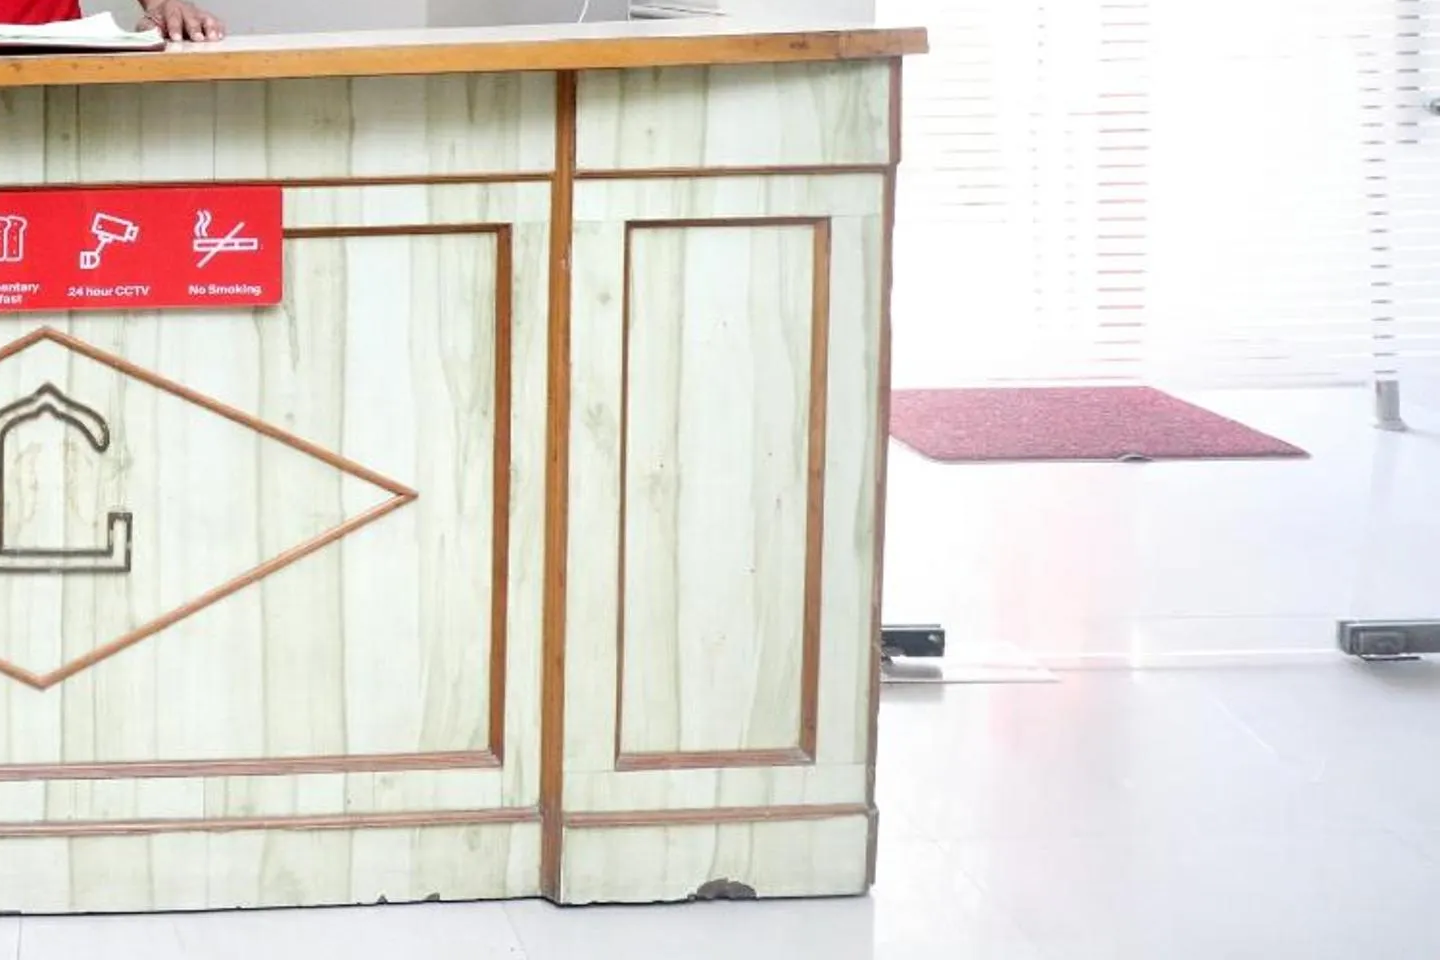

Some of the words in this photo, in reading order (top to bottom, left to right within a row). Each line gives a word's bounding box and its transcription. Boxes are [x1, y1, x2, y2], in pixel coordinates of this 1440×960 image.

[67, 286, 84, 297] 24
[86, 286, 113, 297] hour
[114, 285, 151, 297] CCTV
[188, 284, 206, 295] No
[207, 283, 262, 297] Smoking
